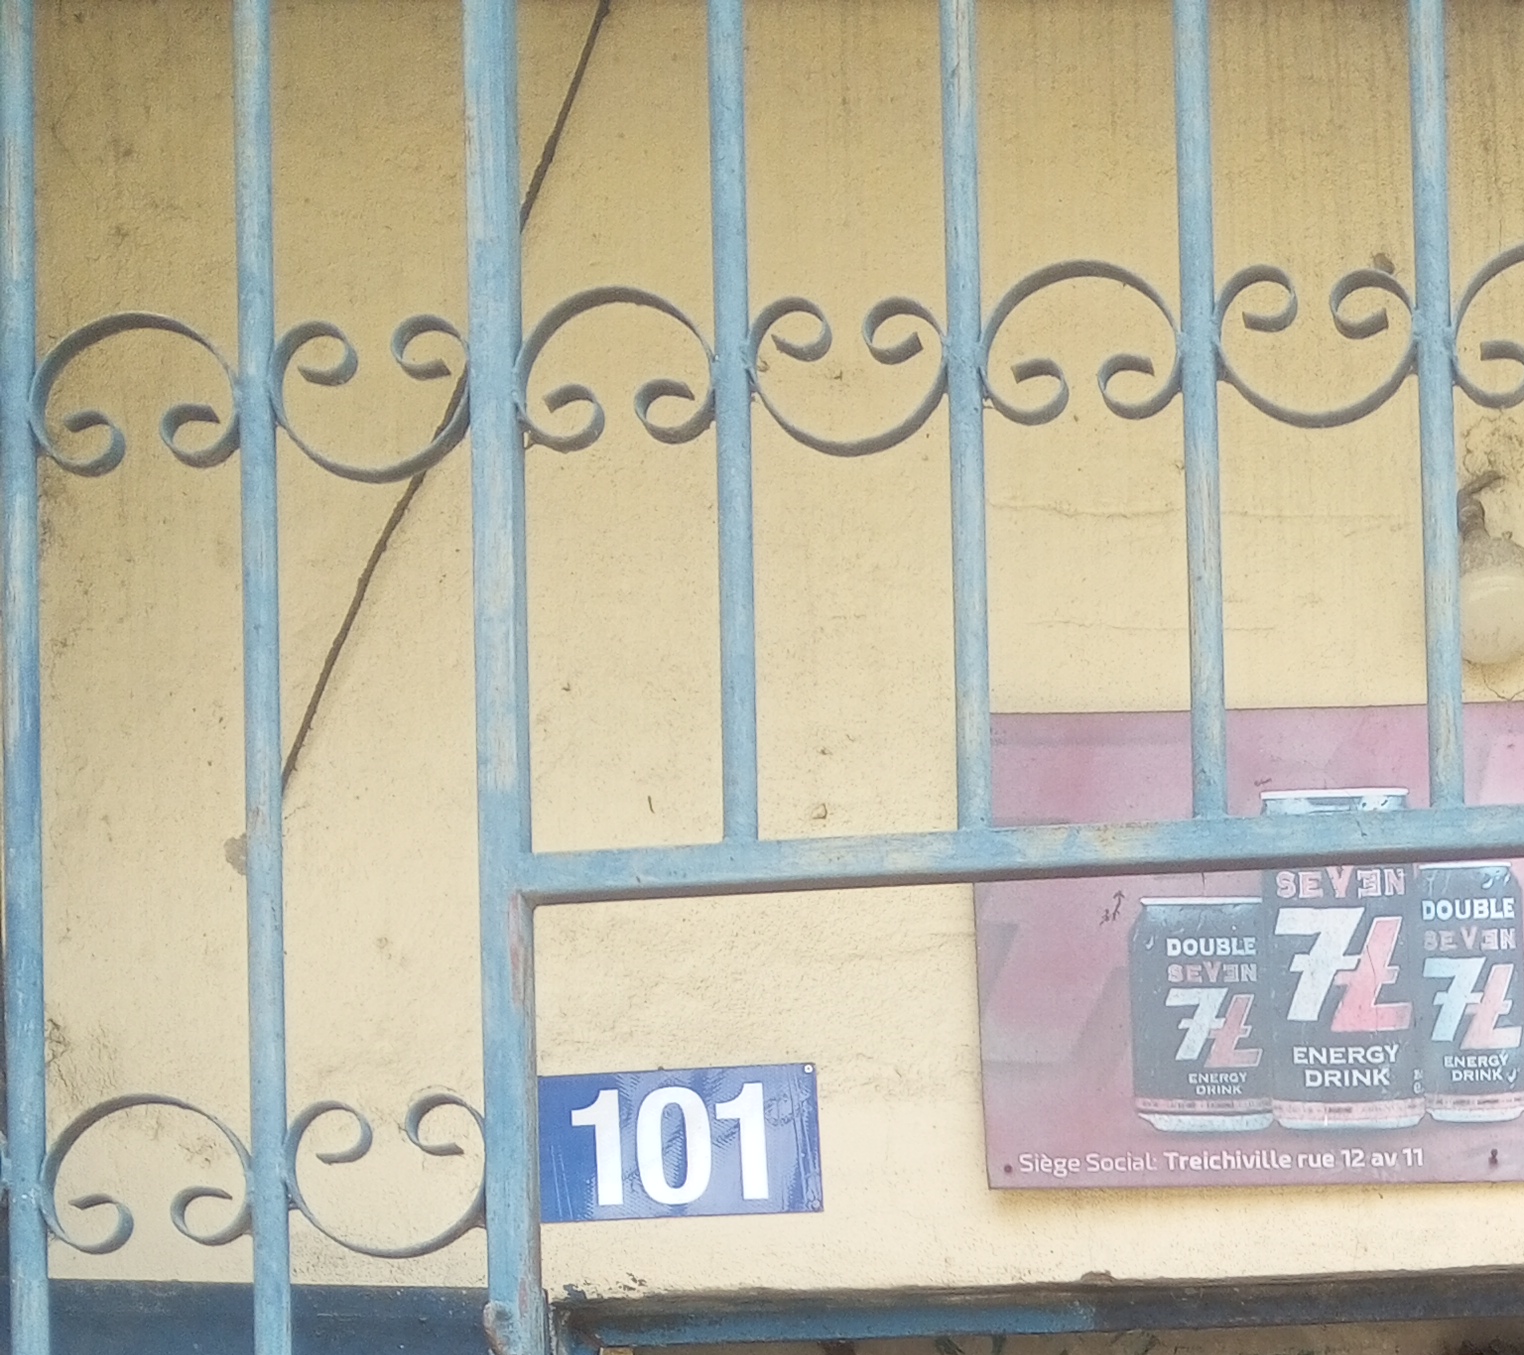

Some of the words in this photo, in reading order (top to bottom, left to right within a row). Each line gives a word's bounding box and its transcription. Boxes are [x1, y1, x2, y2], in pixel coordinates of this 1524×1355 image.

[1422, 898, 1515, 921] DOUBLE
[1166, 937, 1257, 957] DOUBLE
[1292, 1044, 1400, 1066] ENERGY
[1443, 1053, 1510, 1069] ENERGY
[1188, 1072, 1249, 1086] ENERGY
[1304, 1067, 1391, 1088] DRINK
[1451, 1068, 1503, 1083] DRINK
[1195, 1083, 1243, 1096] DRINK
[570, 1082, 770, 1206] 101
[1018, 1151, 1082, 1177] Siège
[1163, 1147, 1293, 1172] Treichiville
[1297, 1151, 1335, 1169] rue
[1340, 1148, 1366, 1169] 12
[1371, 1151, 1399, 1168] av
[1402, 1147, 1425, 1167] 11
